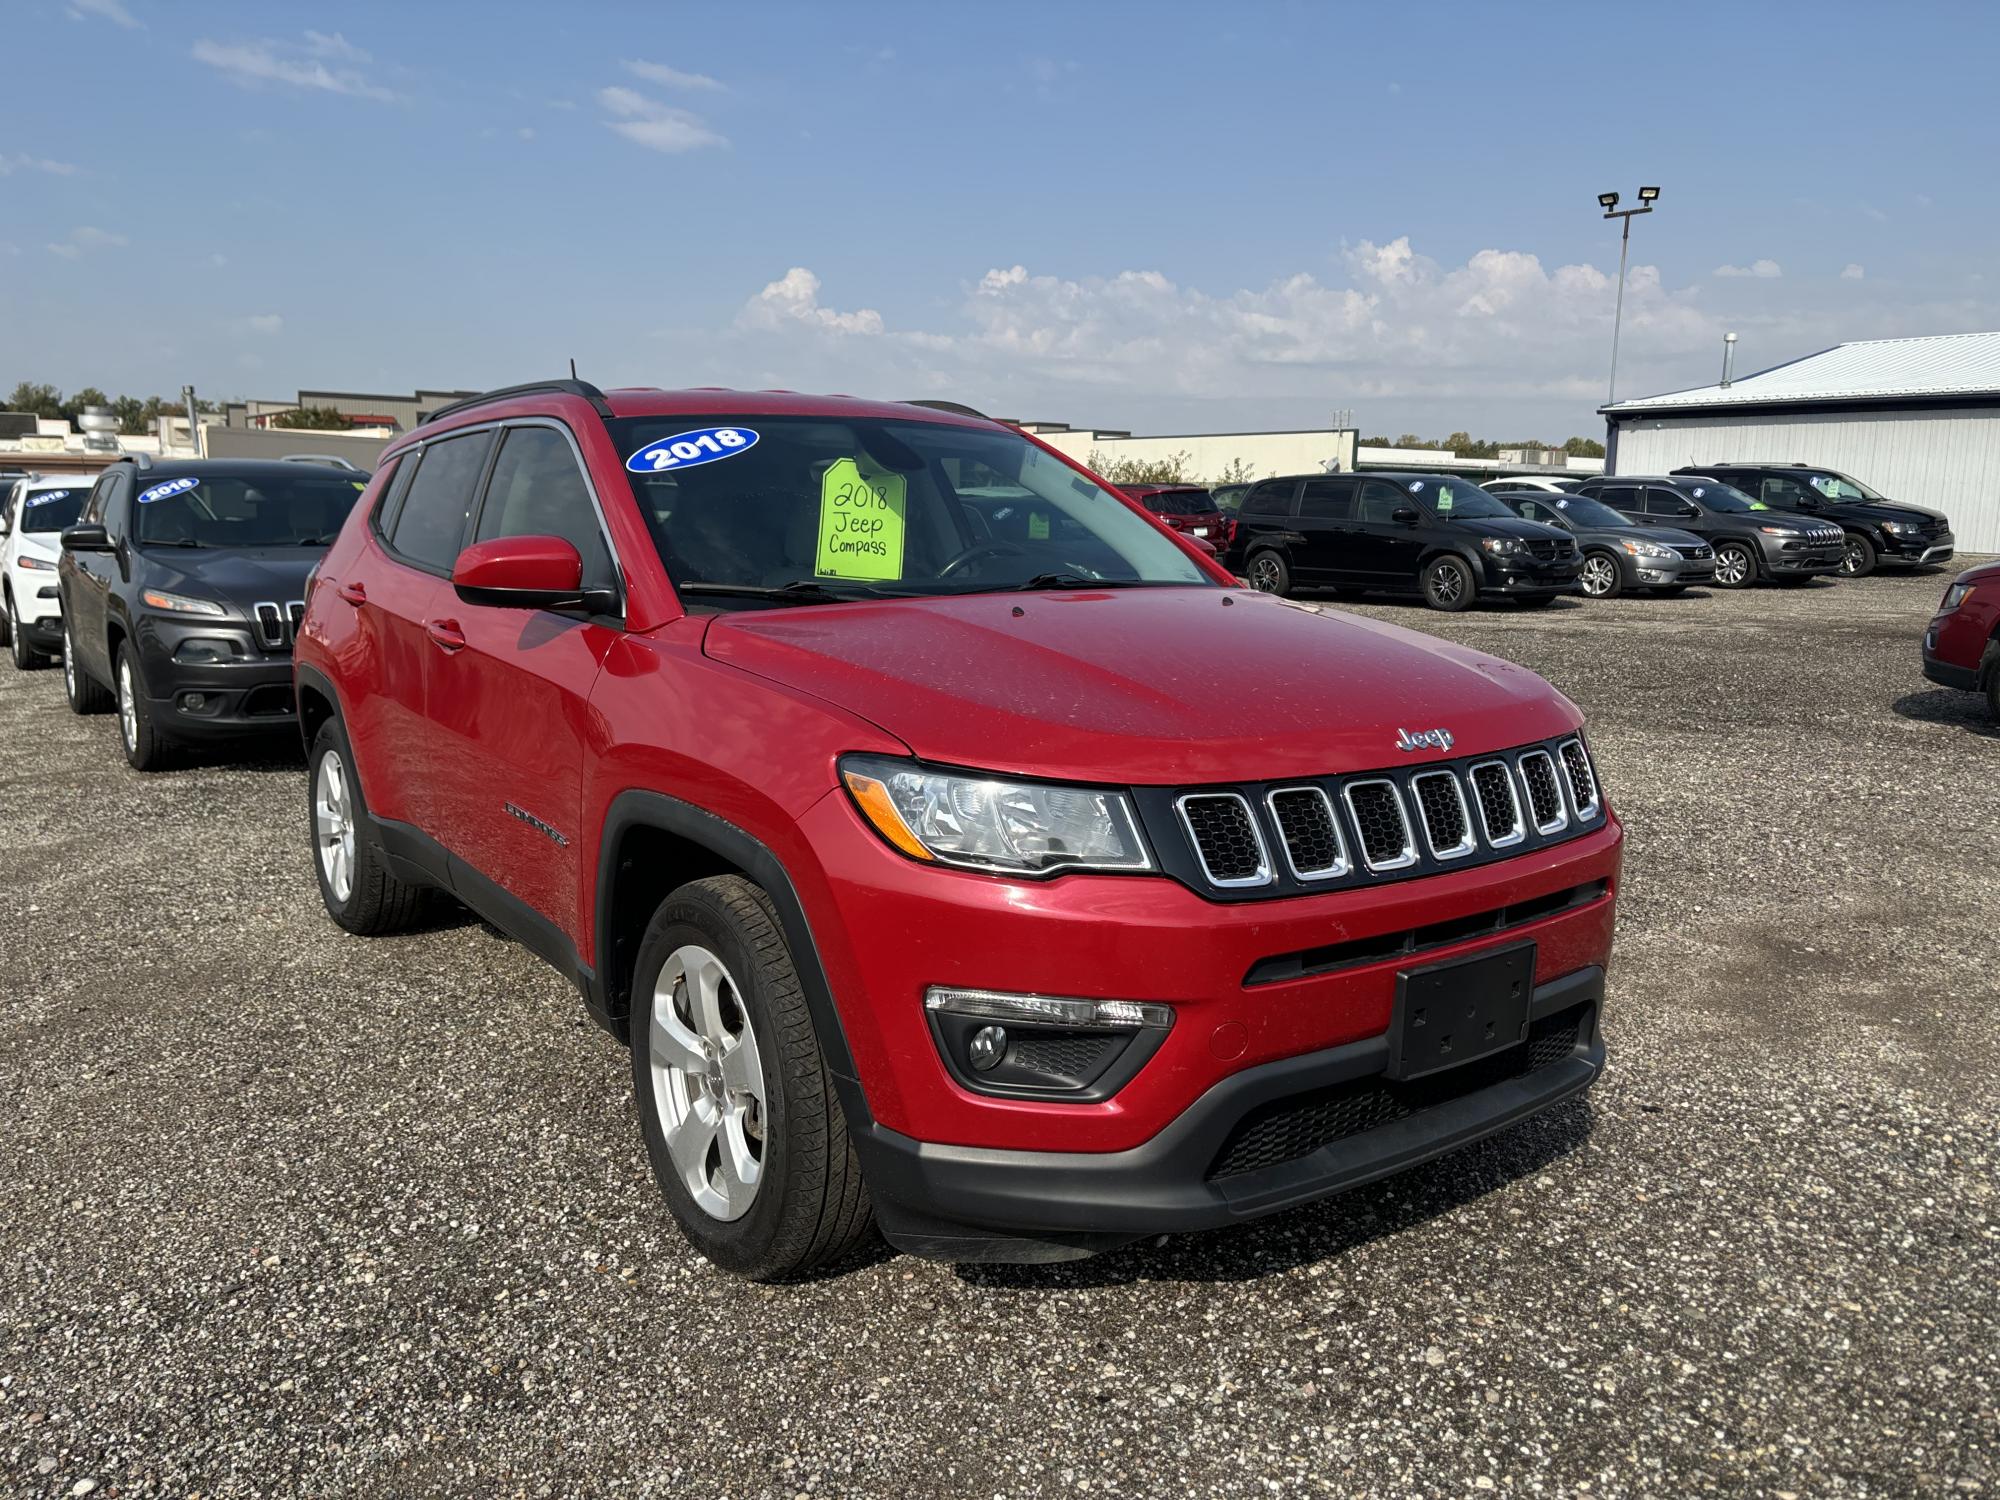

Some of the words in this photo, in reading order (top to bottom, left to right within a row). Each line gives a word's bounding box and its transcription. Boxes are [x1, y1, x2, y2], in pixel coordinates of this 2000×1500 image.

[645, 430, 746, 470] 2018
[834, 482, 887, 510] 2018
[833, 511, 884, 539] Jeep
[829, 533, 887, 557] Compass
[1395, 727, 1455, 753] Jeep
